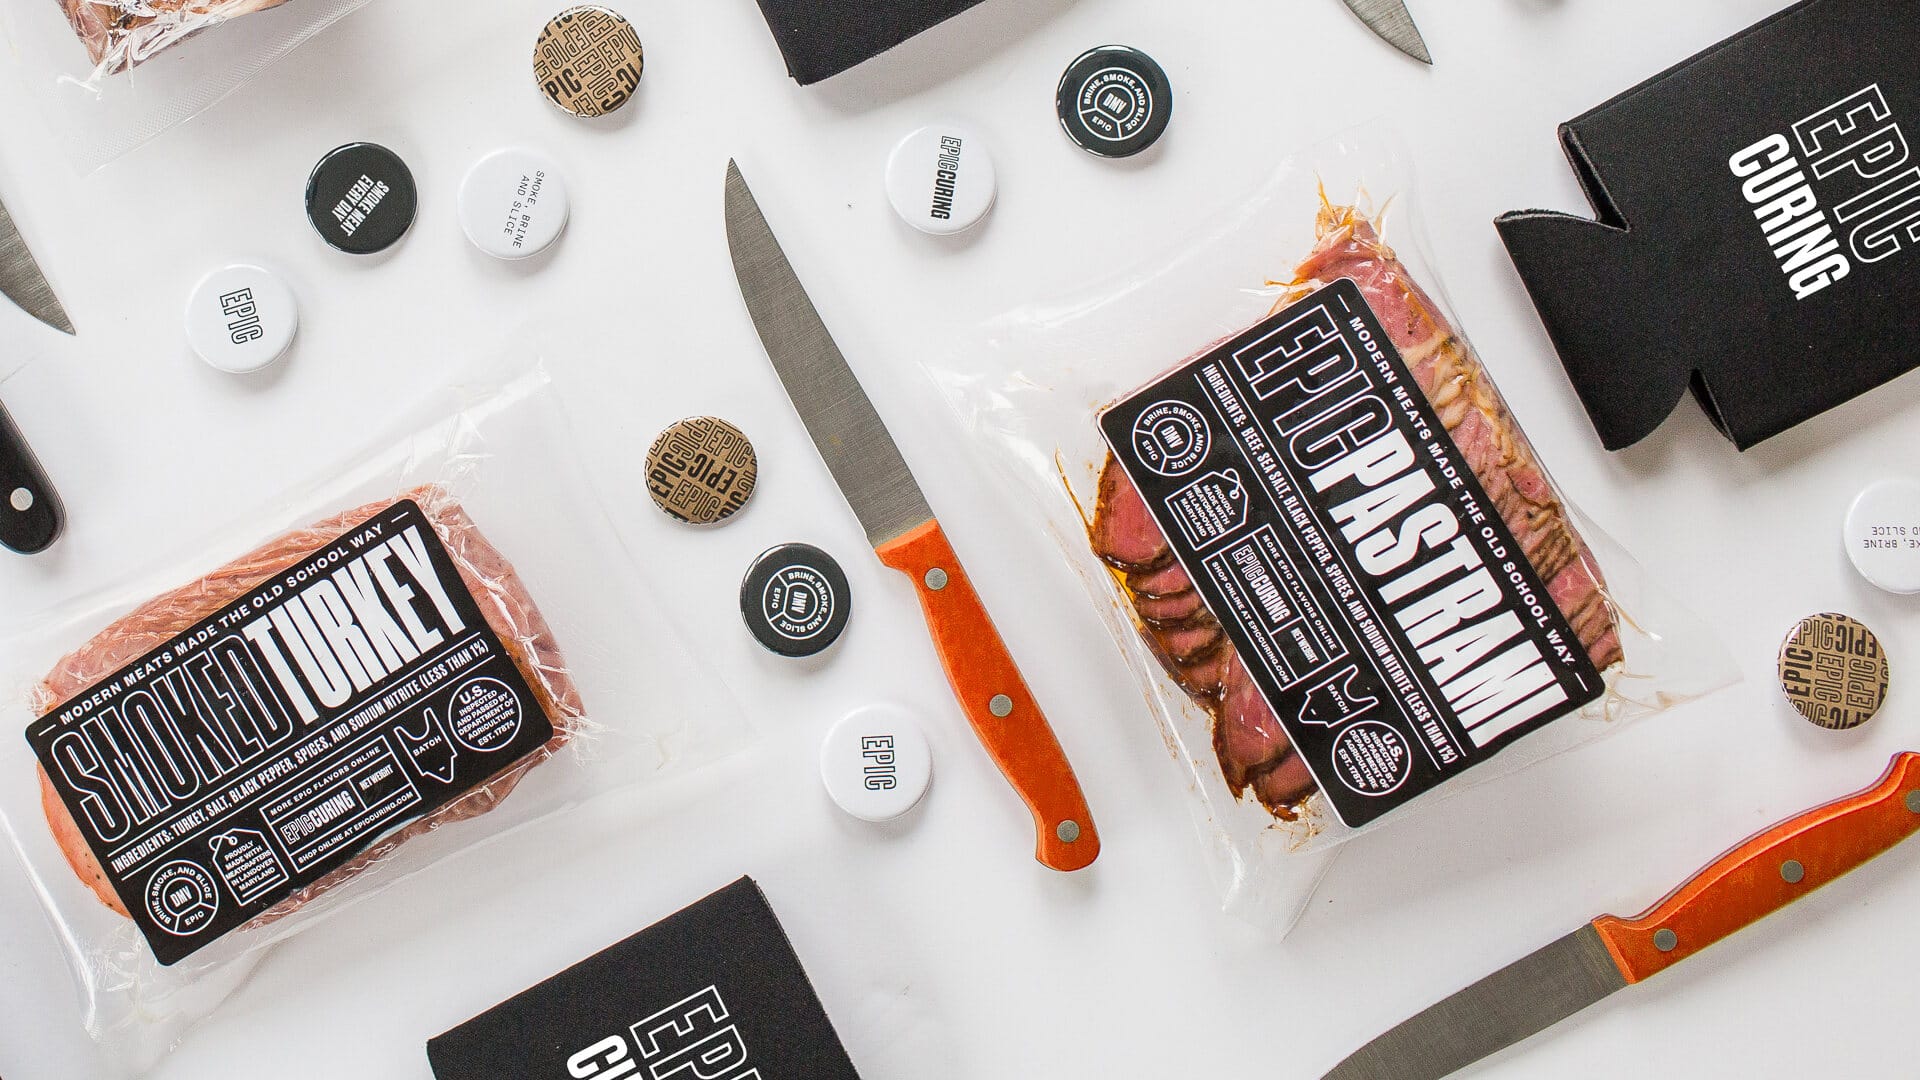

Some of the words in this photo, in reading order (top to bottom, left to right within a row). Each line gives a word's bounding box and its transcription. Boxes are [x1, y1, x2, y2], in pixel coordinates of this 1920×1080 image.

[542, 23, 592, 70] EPIC
[545, 68, 582, 104] PIC
[572, 49, 618, 100] EPIC
[1103, 74, 1136, 89] SMOKE,
[1084, 79, 1104, 104] BRINE,
[1103, 92, 1127, 114] DMV
[1134, 88, 1146, 106] AND
[1092, 116, 1112, 132] EPIC
[1125, 108, 1145, 131] SLICE
[346, 174, 374, 206] EVERY
[358, 180, 390, 214] SMOKE
[518, 175, 530, 196] AND
[524, 170, 544, 208] SMOKE,
[332, 200, 352, 222] DAY
[340, 208, 366, 236] MEAT
[504, 200, 522, 236] SLICE
[1729, 133, 1850, 300] CURING
[513, 214, 530, 248] BRINE
[220, 288, 263, 344] EPIC
[1143, 407, 1172, 426] BRINE,
[1173, 407, 1201, 432] SMOKE,
[703, 425, 752, 468] EPIC
[1142, 440, 1158, 460] EPIC
[1161, 425, 1184, 448] DMV
[1194, 433, 1204, 452] AND
[688, 454, 738, 495] EPIC
[1171, 452, 1197, 469] SLICE
[669, 479, 721, 522] EPIC
[1212, 484, 1236, 516] PROUDLY
[1349, 316, 1398, 384] MODERN
[1392, 386, 1432, 440] MEATS
[1428, 442, 1464, 489] MADE
[1460, 490, 1485, 524] THE
[1482, 527, 1506, 558] OLD
[1503, 562, 1548, 628] SCHOOL
[1546, 629, 1575, 662] WAY
[1180, 498, 1207, 536] MARYLAND
[1186, 490, 1194, 499] IN
[1190, 498, 1216, 536] LANDOVER
[1202, 485, 1219, 506] MADE
[1215, 505, 1230, 524] WITH
[1864, 540, 1898, 548] BRINE
[1872, 526, 1906, 536] SLICE
[788, 572, 816, 584] BRINE,
[1202, 364, 1246, 427] INGREDIENTS:
[1241, 427, 1264, 455] BEEF,
[1257, 452, 1276, 474] SEA
[1268, 471, 1291, 499] SALT,
[1283, 496, 1310, 528] BLACK
[1301, 526, 1332, 566] PEPPER,
[1326, 564, 1354, 602] SPICES,
[1346, 600, 1368, 620] AND
[1359, 619, 1390, 656] SODIUM
[1381, 654, 1414, 694] NITRITE
[1404, 692, 1431, 722] (LESS
[1423, 719, 1447, 747] THAN
[1438, 745, 1458, 764] 1%)
[772, 588, 781, 608] EPIC
[791, 592, 808, 614] DMV
[815, 581, 828, 614] SMOKE,
[1212, 562, 1228, 582] SHOP
[1225, 582, 1245, 610] ONLINE
[1241, 611, 1252, 620] AT
[1262, 534, 1280, 559] MORE
[1278, 560, 1293, 580] EPIC
[1291, 580, 1317, 618] FLAVORS
[1315, 620, 1337, 650] ONLINE
[60, 682, 122, 725] MODERN
[123, 652, 172, 686] MEATS
[174, 624, 218, 656] MADE
[218, 604, 250, 628] THE
[253, 585, 283, 608] OLD
[286, 547, 349, 587] SCHOOL
[350, 523, 382, 548] WAY
[780, 620, 806, 632] SLICE
[806, 614, 822, 630] AND
[1783, 647, 1814, 697] EPIC
[1814, 652, 1846, 703] EPIC
[1846, 659, 1877, 710] EPIC
[459, 685, 487, 704] U.S.
[459, 690, 501, 716] INSPECTED
[1327, 684, 1349, 713] BATCH
[457, 715, 472, 728] AND
[471, 699, 498, 718] PASSED
[498, 692, 508, 702] BY
[458, 704, 508, 736] DEPARTMENT
[504, 698, 514, 707] OF
[465, 708, 515, 740] AGRICULTURE
[413, 736, 442, 756] BATCH
[478, 732, 495, 746] EST.
[1370, 731, 1398, 772] INSPECTED
[1382, 732, 1402, 762] U.S.
[111, 830, 174, 873] INGREDIENTS:
[170, 809, 209, 836] TURKEY,
[205, 795, 232, 816] SALT,
[228, 777, 261, 803] BLACK
[257, 758, 298, 786] PEPPER,
[294, 736, 333, 764] SPICES,
[330, 723, 350, 743] AND
[348, 701, 386, 731] SODIUM
[383, 680, 422, 710] NITRITE
[419, 664, 448, 688] (LESS
[445, 648, 472, 671] THAN
[470, 639, 488, 657] 1%)
[862, 736, 896, 790] EPIC
[1338, 748, 1352, 766] EST.
[1344, 740, 1378, 789] AGRICULTURE
[1349, 730, 1383, 778] DEPARTMENT
[1379, 778, 1390, 788] OF
[1358, 729, 1371, 744] AND
[1368, 743, 1388, 773] PASSED
[1385, 772, 1396, 782] BY
[270, 799, 293, 816] MORE
[293, 788, 312, 802] EPIC
[313, 765, 349, 790] FLAVORS
[351, 746, 380, 767] ONLINE
[224, 840, 257, 861] PROUDLY
[225, 856, 245, 870] MADE
[244, 845, 262, 859] WITH
[298, 849, 317, 863] SHOP
[318, 833, 344, 852] ONLINE
[344, 827, 353, 837] AT
[152, 869, 176, 896] SMOKE,
[177, 867, 195, 876] AND
[196, 874, 212, 898] SLICE
[231, 878, 240, 886] IN
[238, 858, 274, 882] LANDOVER
[239, 867, 275, 891] MARYLAND
[152, 898, 171, 924] BRINE,
[170, 886, 192, 907] DMV
[184, 911, 204, 926] EPIC
